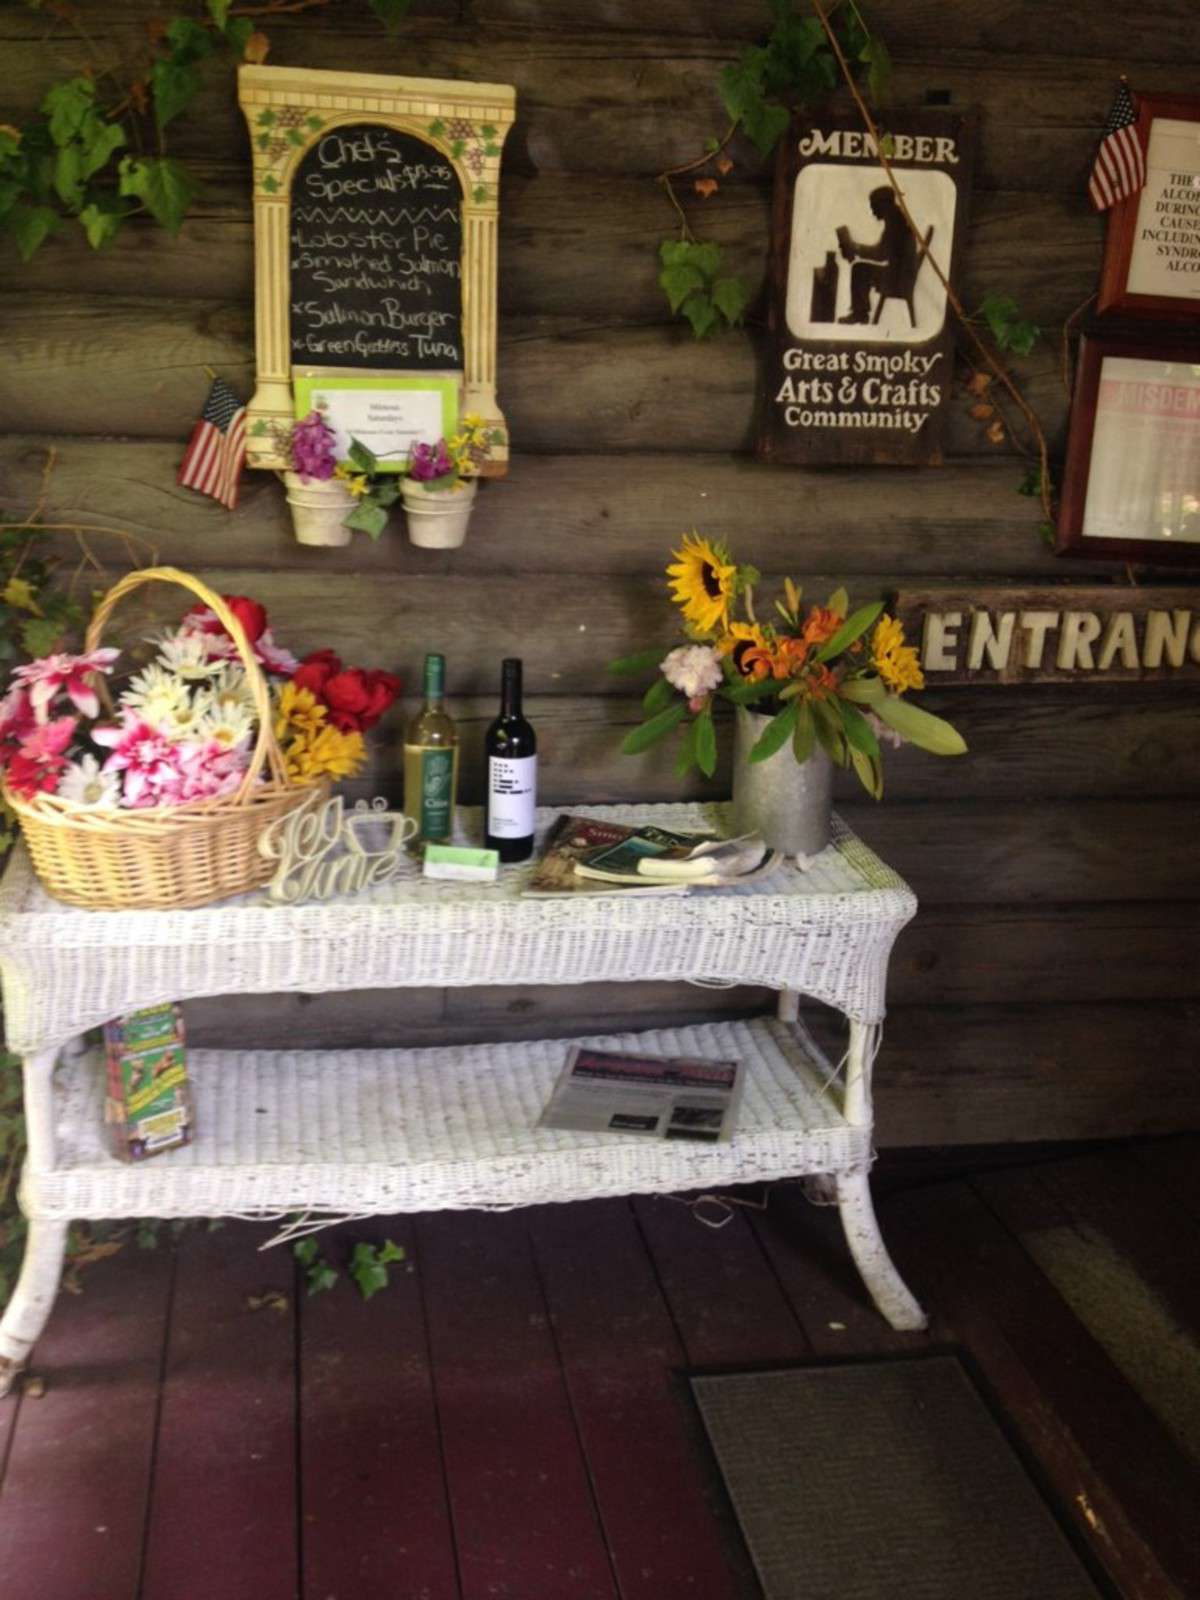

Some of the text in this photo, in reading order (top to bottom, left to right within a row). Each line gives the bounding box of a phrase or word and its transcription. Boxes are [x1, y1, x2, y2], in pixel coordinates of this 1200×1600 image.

[798, 128, 960, 163] MEMBER
[298, 227, 406, 249] Lobster
[409, 333, 459, 361] Tuna
[783, 348, 943, 379] Great Smoky
[775, 375, 942, 407] Arts & Crafts
[784, 406, 930, 434] Community
